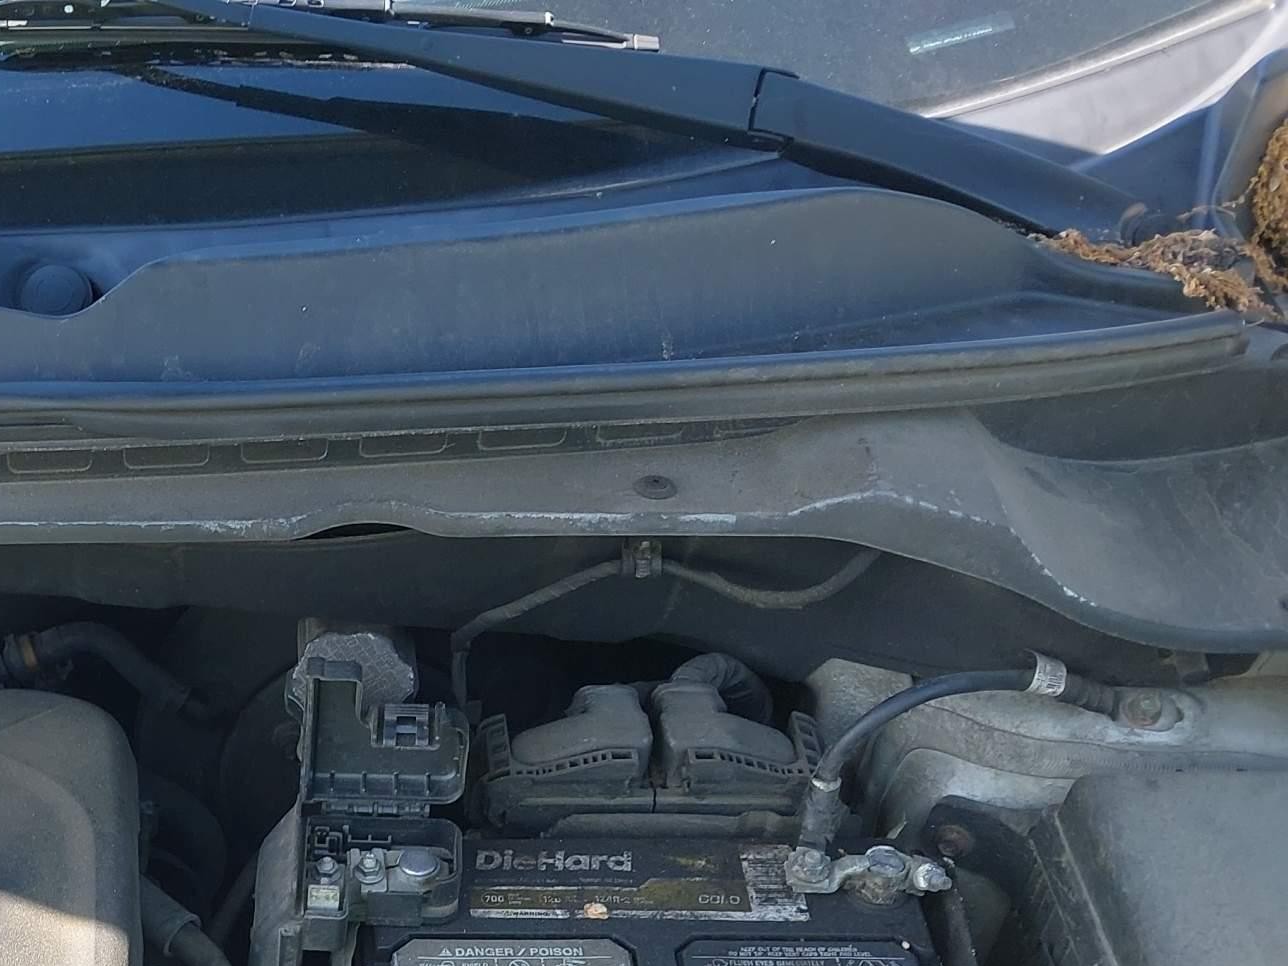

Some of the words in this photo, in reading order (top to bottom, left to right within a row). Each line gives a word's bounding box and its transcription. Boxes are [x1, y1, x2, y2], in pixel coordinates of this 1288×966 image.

[475, 850, 633, 872] DieHard
[484, 895, 505, 903] 700
[455, 947, 514, 957] DANGER
[529, 947, 584, 956] POISON
